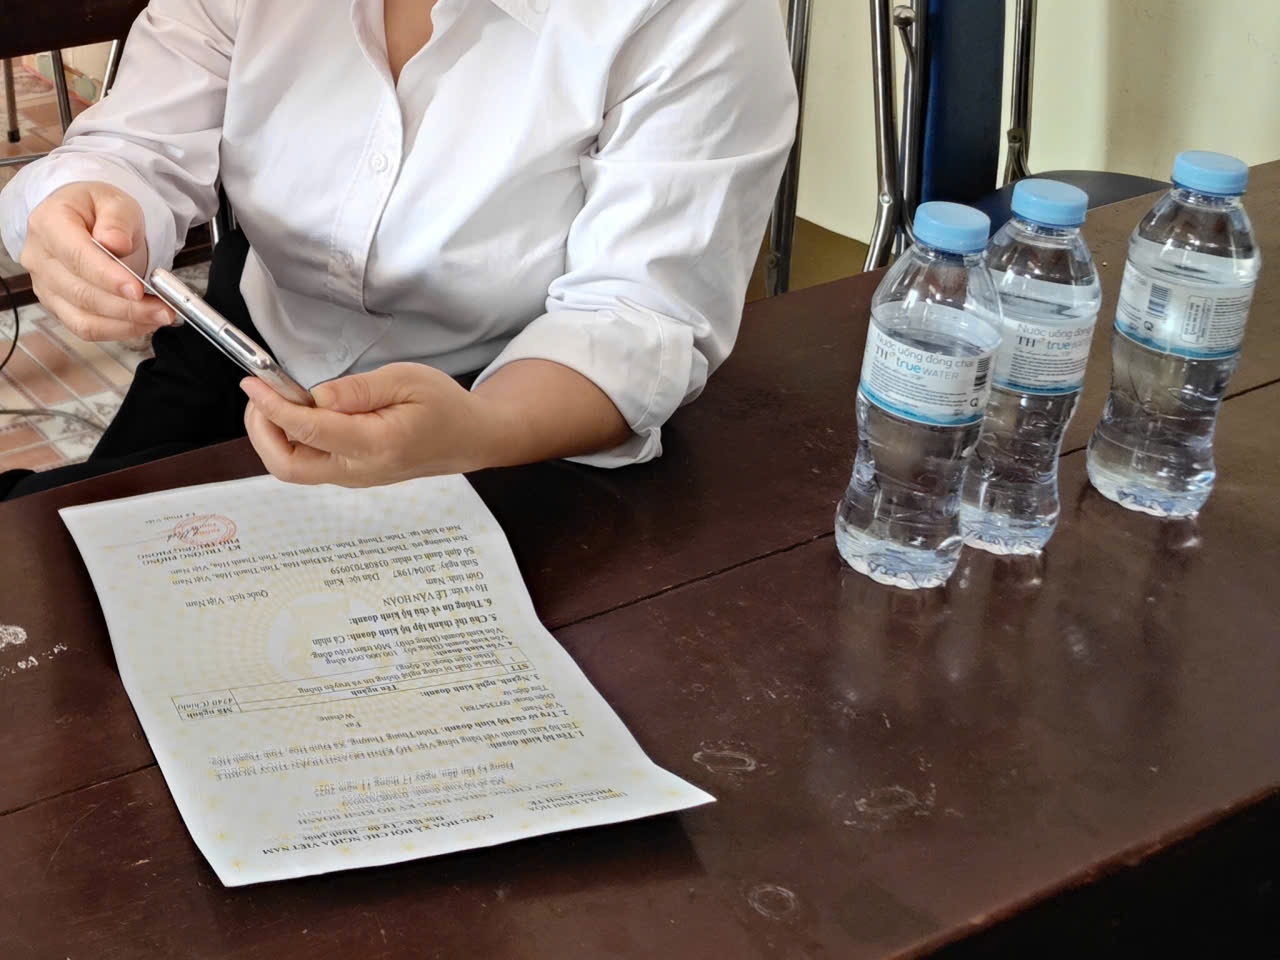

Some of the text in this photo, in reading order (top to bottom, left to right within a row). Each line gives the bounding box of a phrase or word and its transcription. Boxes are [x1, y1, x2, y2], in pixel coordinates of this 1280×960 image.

[1047, 340, 1071, 350] true
[896, 357, 922, 374] true
[922, 366, 960, 380] WATER
